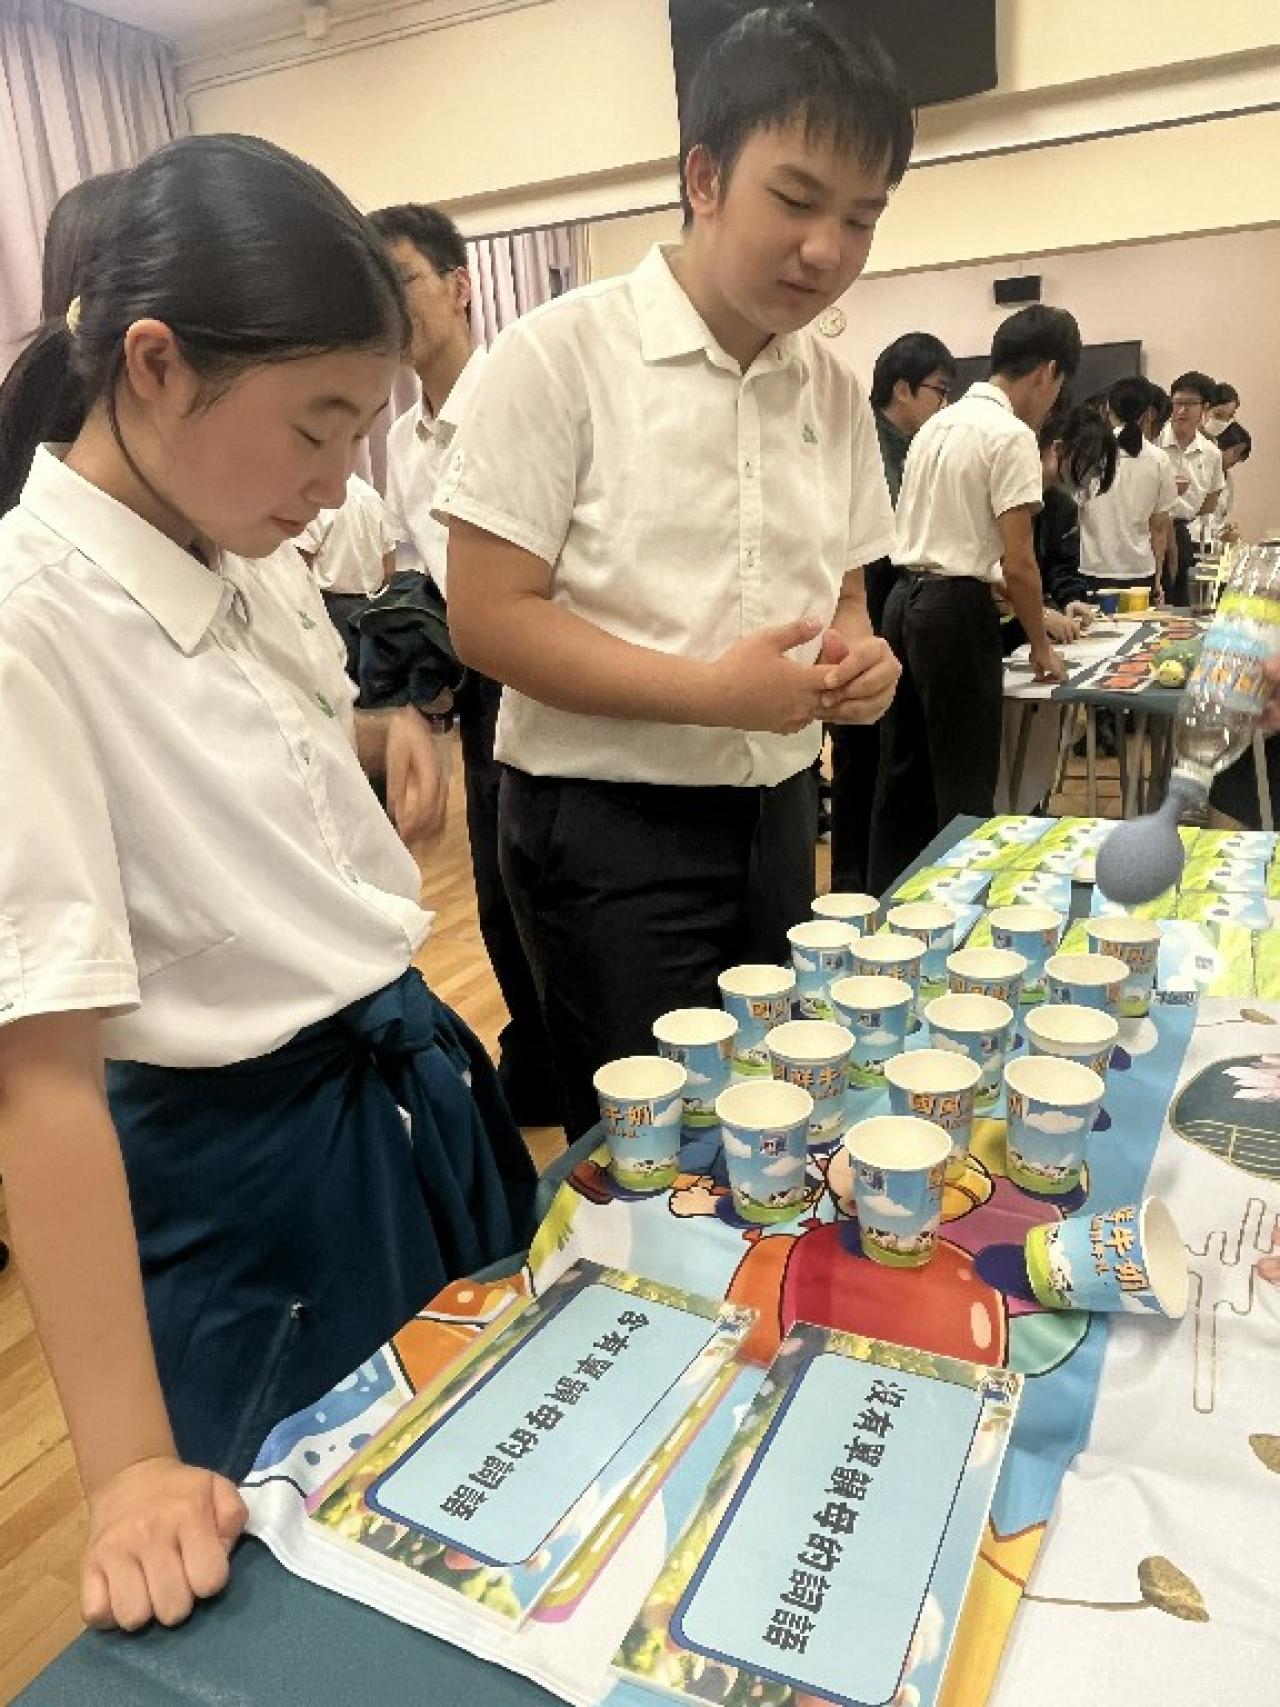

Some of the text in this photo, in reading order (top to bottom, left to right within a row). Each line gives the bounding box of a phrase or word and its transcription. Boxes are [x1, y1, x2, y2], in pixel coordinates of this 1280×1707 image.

[439, 1310, 650, 1521] 含有單韻母的詞語
[761, 1379, 908, 1655] 沒有單韻母的詞語
